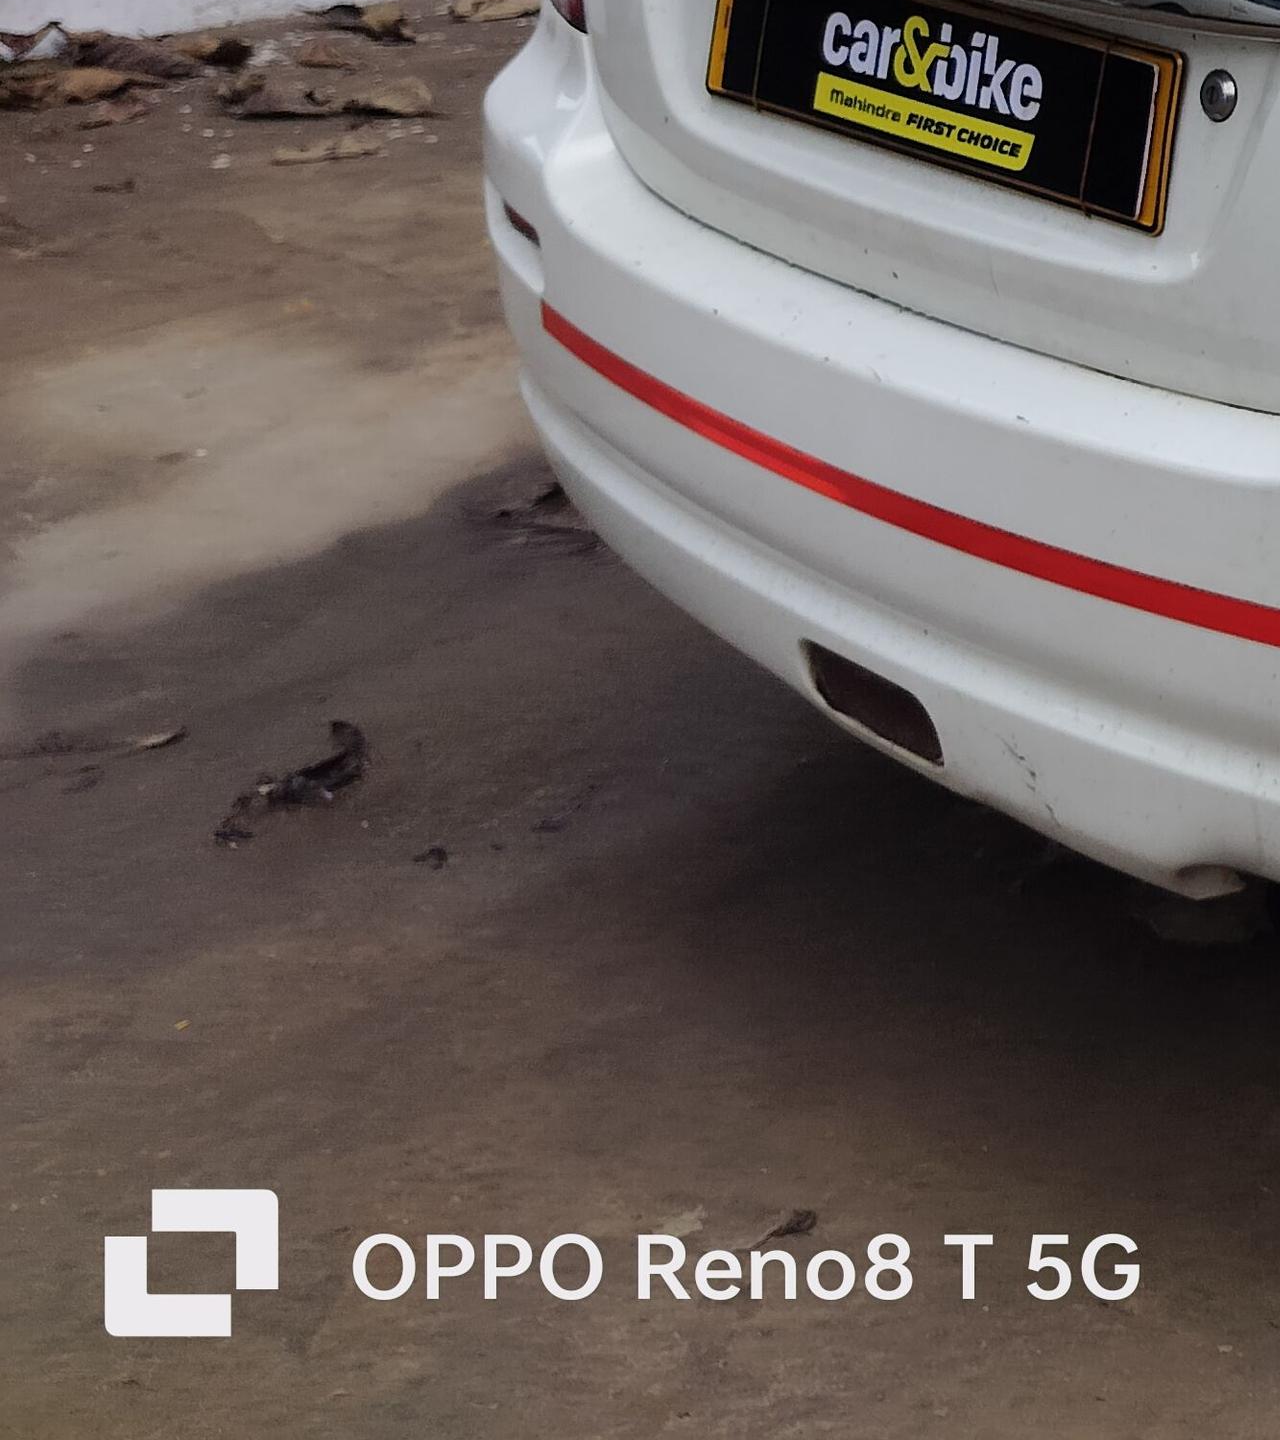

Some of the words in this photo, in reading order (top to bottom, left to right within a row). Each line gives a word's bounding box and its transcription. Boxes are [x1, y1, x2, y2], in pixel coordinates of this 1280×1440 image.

[823, 11, 1043, 121] car&bike
[905, 112, 957, 138] FIRST
[956, 127, 1022, 158] CHOICE
